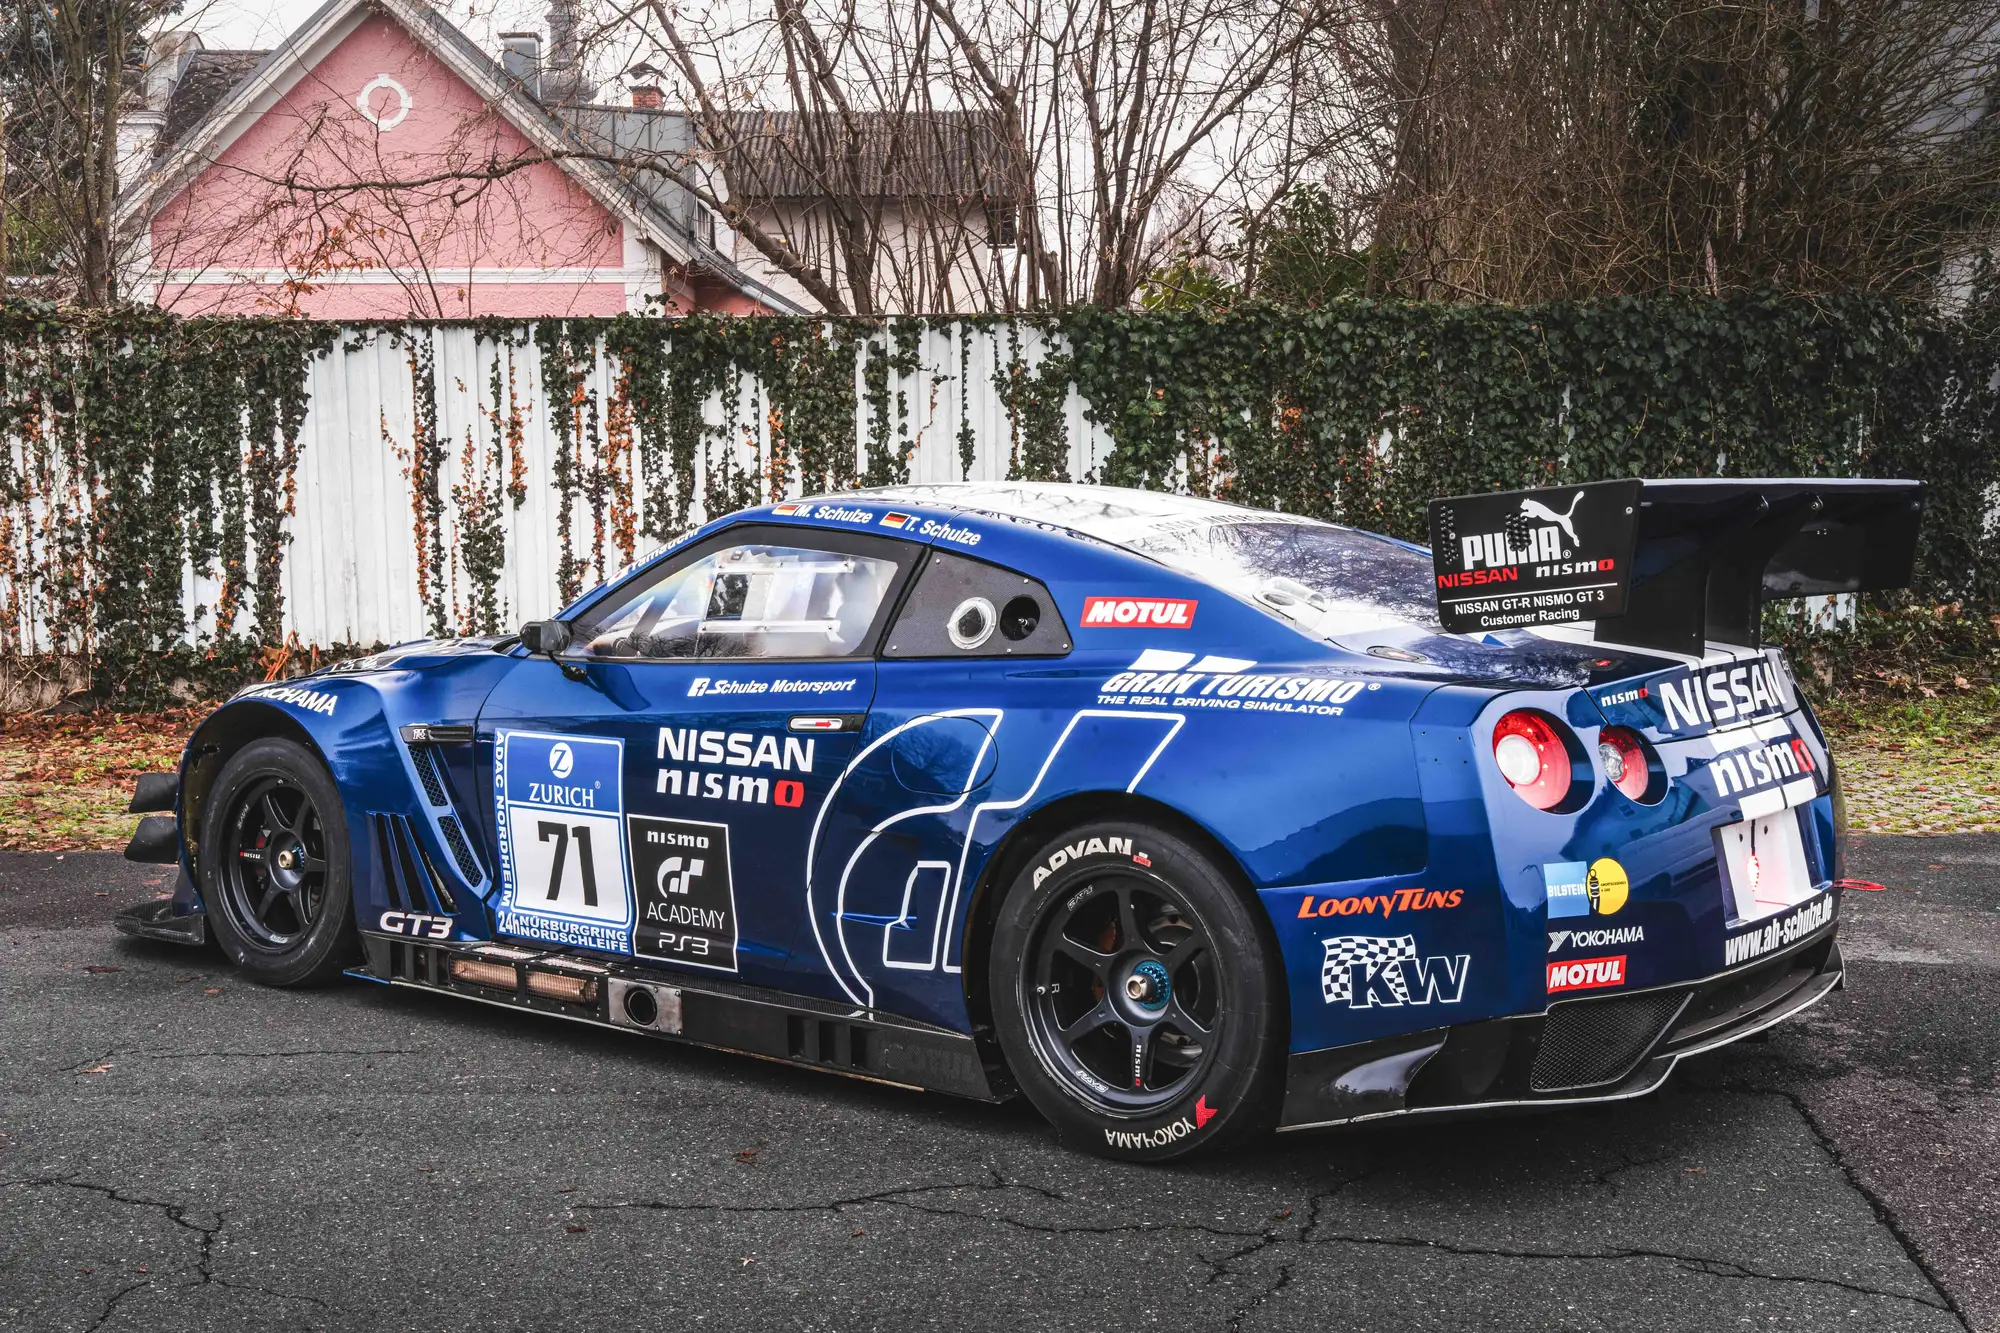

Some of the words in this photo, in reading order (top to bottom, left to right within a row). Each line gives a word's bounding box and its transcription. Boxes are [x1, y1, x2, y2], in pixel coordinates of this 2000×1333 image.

[794, 504, 811, 518] M.
[815, 505, 874, 524] Schulze
[905, 516, 917, 532] T.
[919, 519, 982, 546] Schulze
[1437, 567, 1518, 589] NISSAN
[1536, 558, 1615, 578] nismo
[1085, 599, 1190, 624] MOTUL
[1455, 601, 1499, 615] NISSAN
[1502, 597, 1531, 611] GT-R
[1533, 592, 1574, 607] NISMO
[1576, 590, 1594, 602] GT
[1597, 590, 1605, 601] 3
[1480, 611, 1537, 627] Customer
[1539, 608, 1580, 622] Racing
[706, 679, 769, 695] Schulze
[769, 677, 857, 694] Motorsport
[1101, 671, 1205, 694] GRAN
[1200, 673, 1365, 704] TURISMO
[1601, 687, 1649, 708] nismo
[1659, 662, 1787, 731] NISSAN
[1097, 694, 1127, 706] THE
[1128, 695, 1168, 706] REAL
[1173, 696, 1241, 710] DRIVING
[1242, 700, 1344, 716] SIMULATOR
[495, 730, 505, 789] ADAC
[657, 727, 815, 773] NISSAN
[1708, 738, 1816, 798] nismo
[529, 782, 595, 808] ZURICH
[656, 768, 805, 808] nismo
[496, 795, 513, 907] NORDHEIM
[647, 830, 709, 849] nismo
[537, 820, 598, 907] 71
[1033, 837, 1133, 891] ADVAN
[1547, 883, 1587, 898] BILSTEIN
[379, 911, 454, 939] GT3
[497, 911, 520, 936] 24h
[520, 916, 627, 942] NÜRBURGRING
[646, 901, 725, 930] ACADEMY
[520, 926, 629, 952] NORDSCHLEIFE
[658, 931, 709, 956] PS3
[1571, 926, 1644, 947] YOKOHAMA
[1725, 893, 1833, 967] www.ah-schulze.de
[1349, 954, 1471, 1009] KW
[1550, 962, 1622, 988] MOTUL
[1134, 1044, 1142, 1087] nismo
[1104, 1115, 1197, 1150] YOKOHAMA
